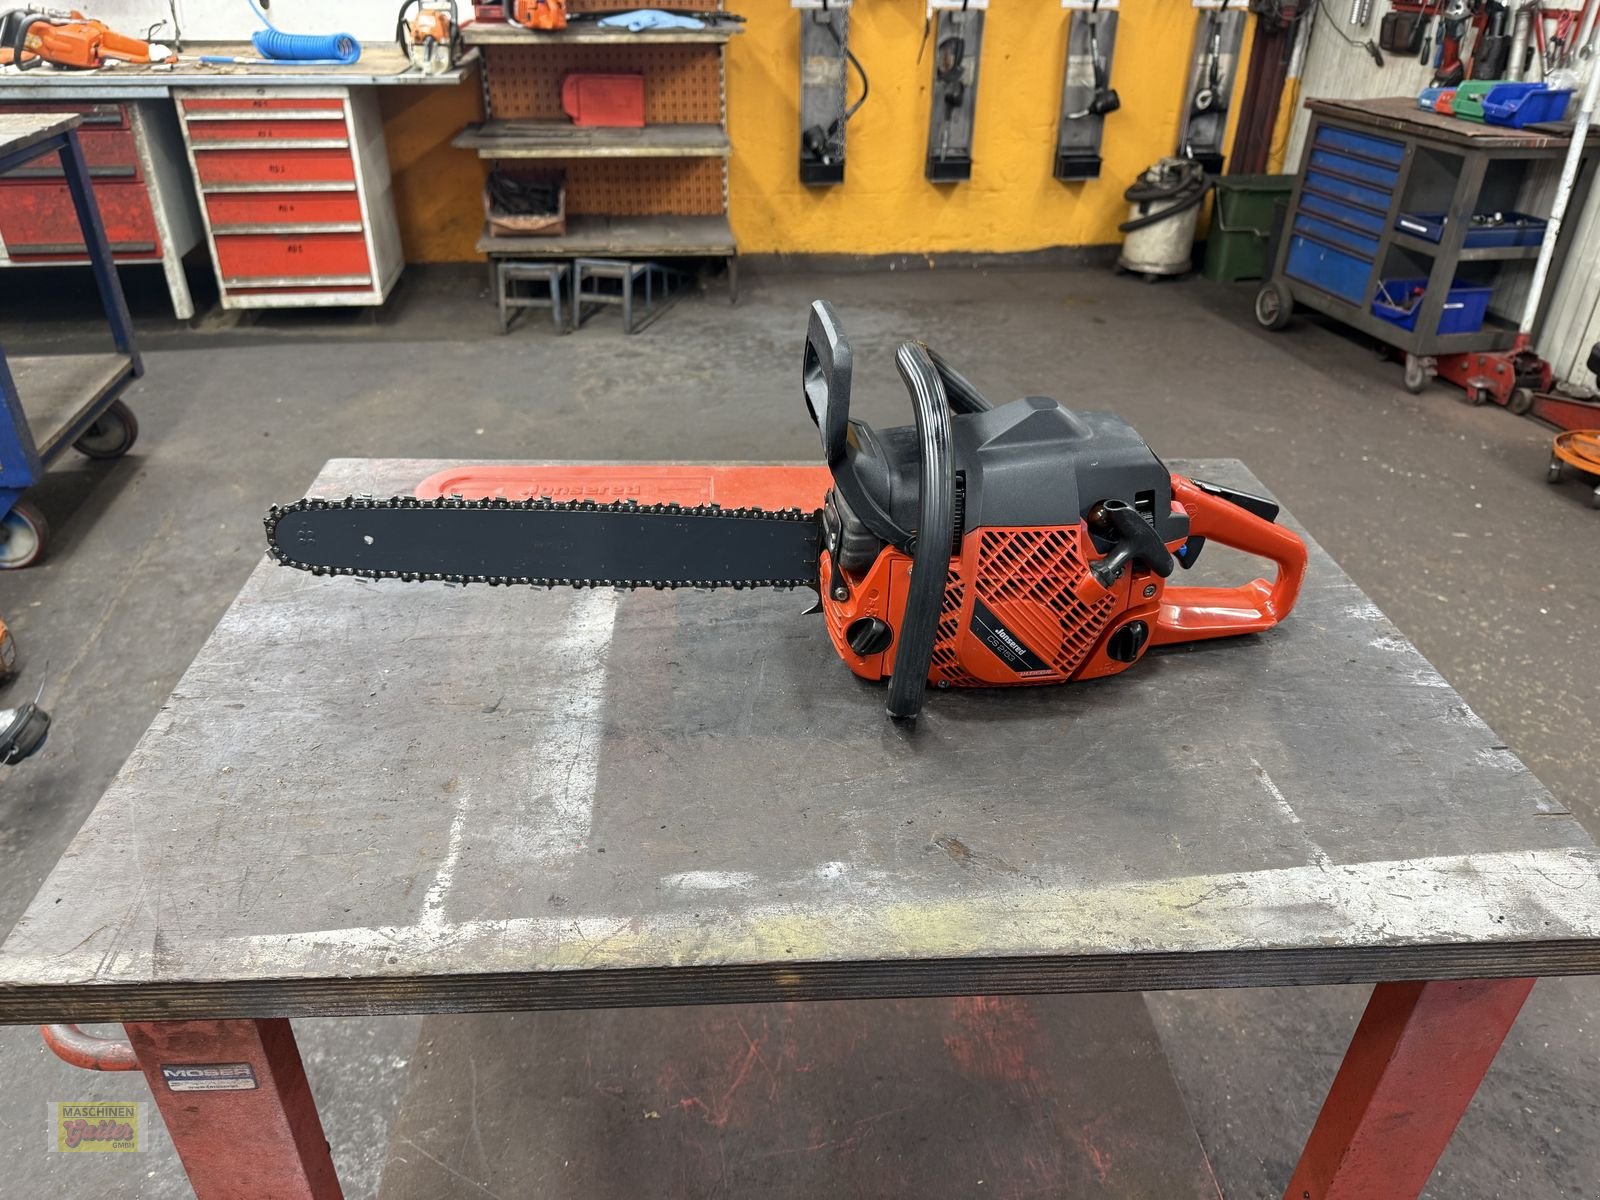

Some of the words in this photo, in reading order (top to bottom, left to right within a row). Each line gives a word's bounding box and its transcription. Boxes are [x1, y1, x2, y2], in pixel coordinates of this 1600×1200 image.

[986, 635, 1000, 647] CS
[994, 628, 1027, 656] Jonsered
[163, 1068, 253, 1078] MOSER
